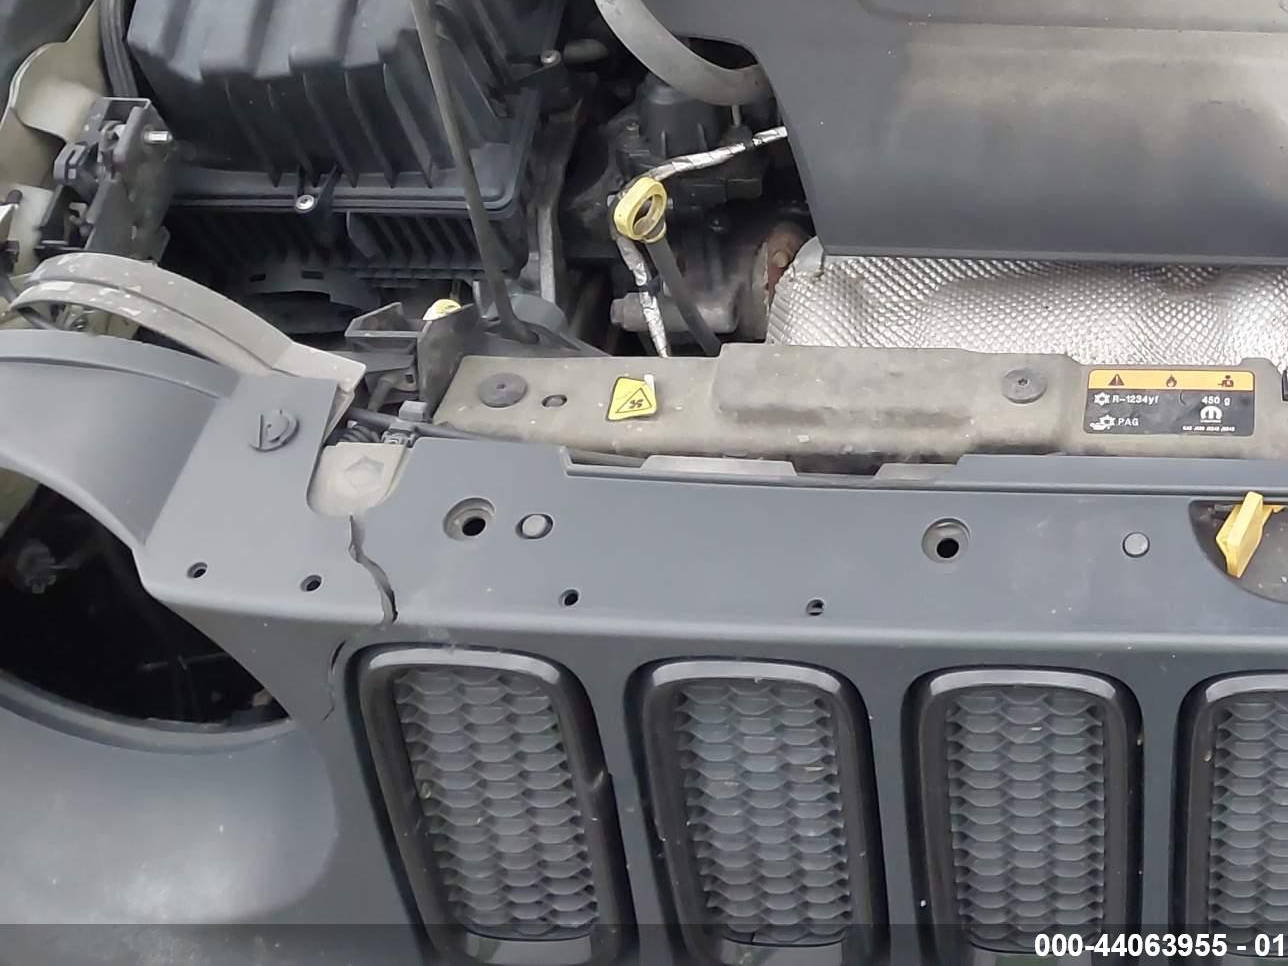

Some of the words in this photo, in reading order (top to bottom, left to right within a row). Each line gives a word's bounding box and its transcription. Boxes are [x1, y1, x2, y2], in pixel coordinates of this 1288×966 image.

[1112, 394, 1159, 405] R-1234yf
[1201, 395, 1221, 405] 450
[1117, 417, 1139, 426] PAG
